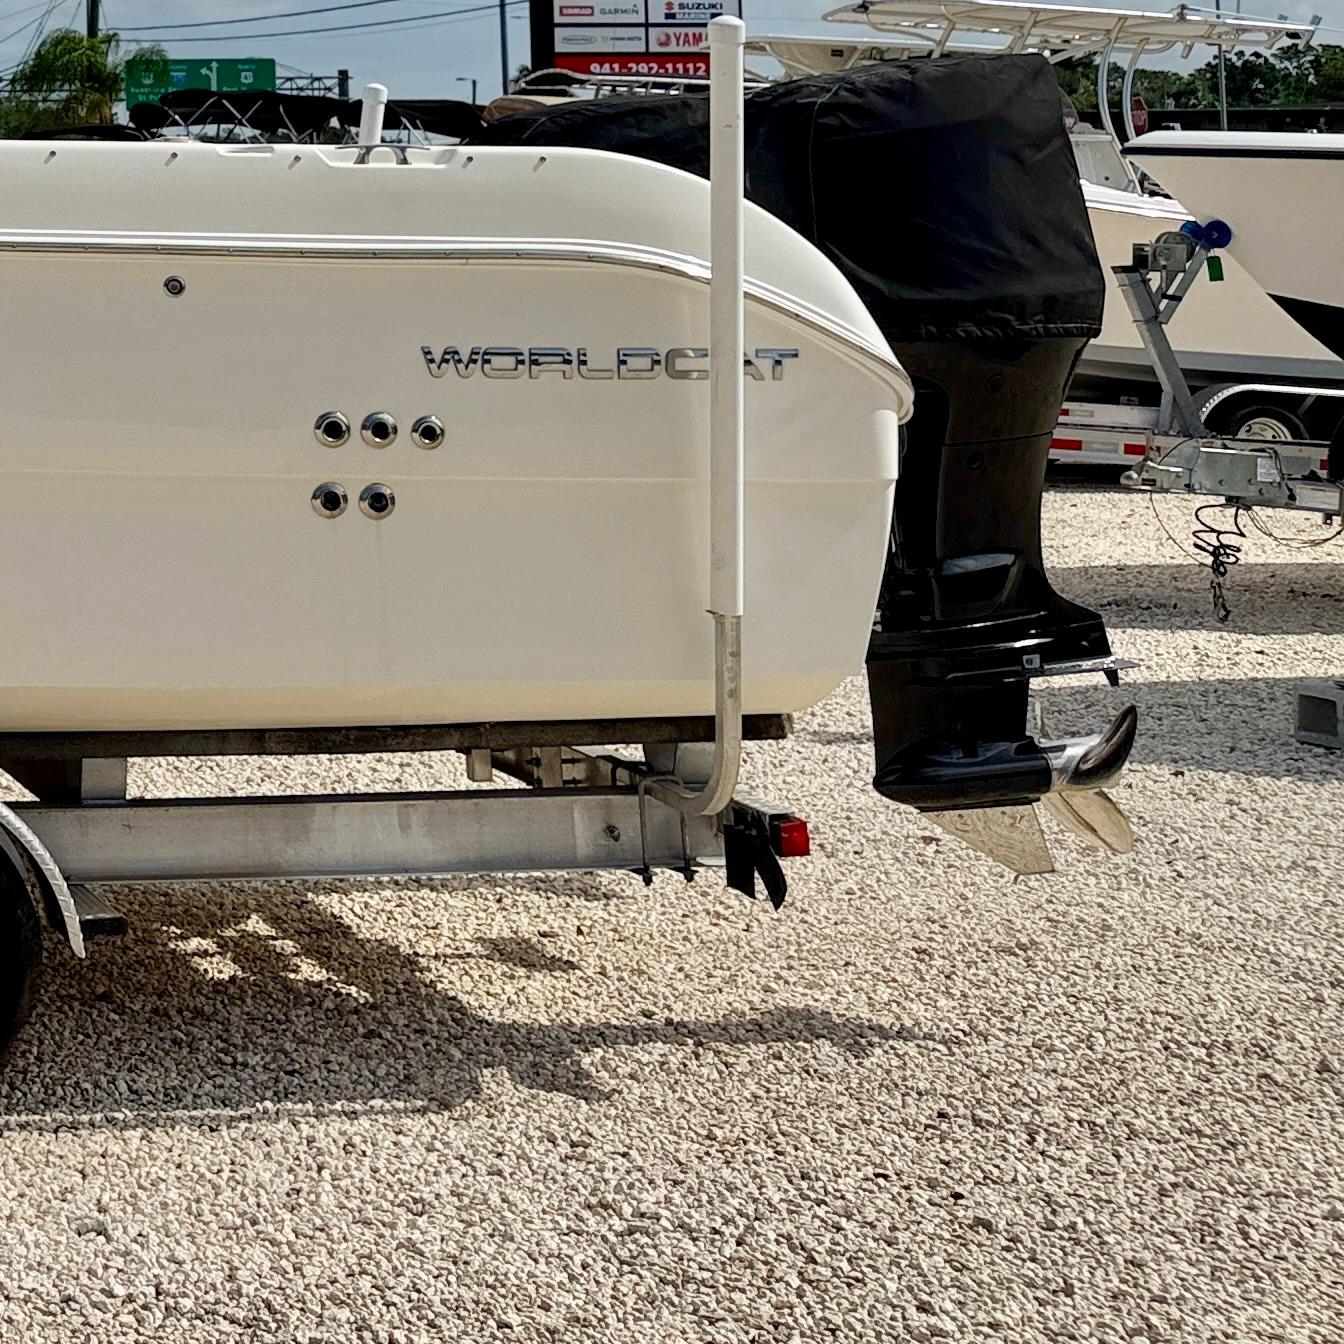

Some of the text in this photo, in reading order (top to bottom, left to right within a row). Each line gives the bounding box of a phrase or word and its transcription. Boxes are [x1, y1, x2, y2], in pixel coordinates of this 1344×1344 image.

[677, 2, 723, 11] SUZUKI
[599, 7, 639, 16] GARMIN
[589, 62, 708, 76] 941-292-1112
